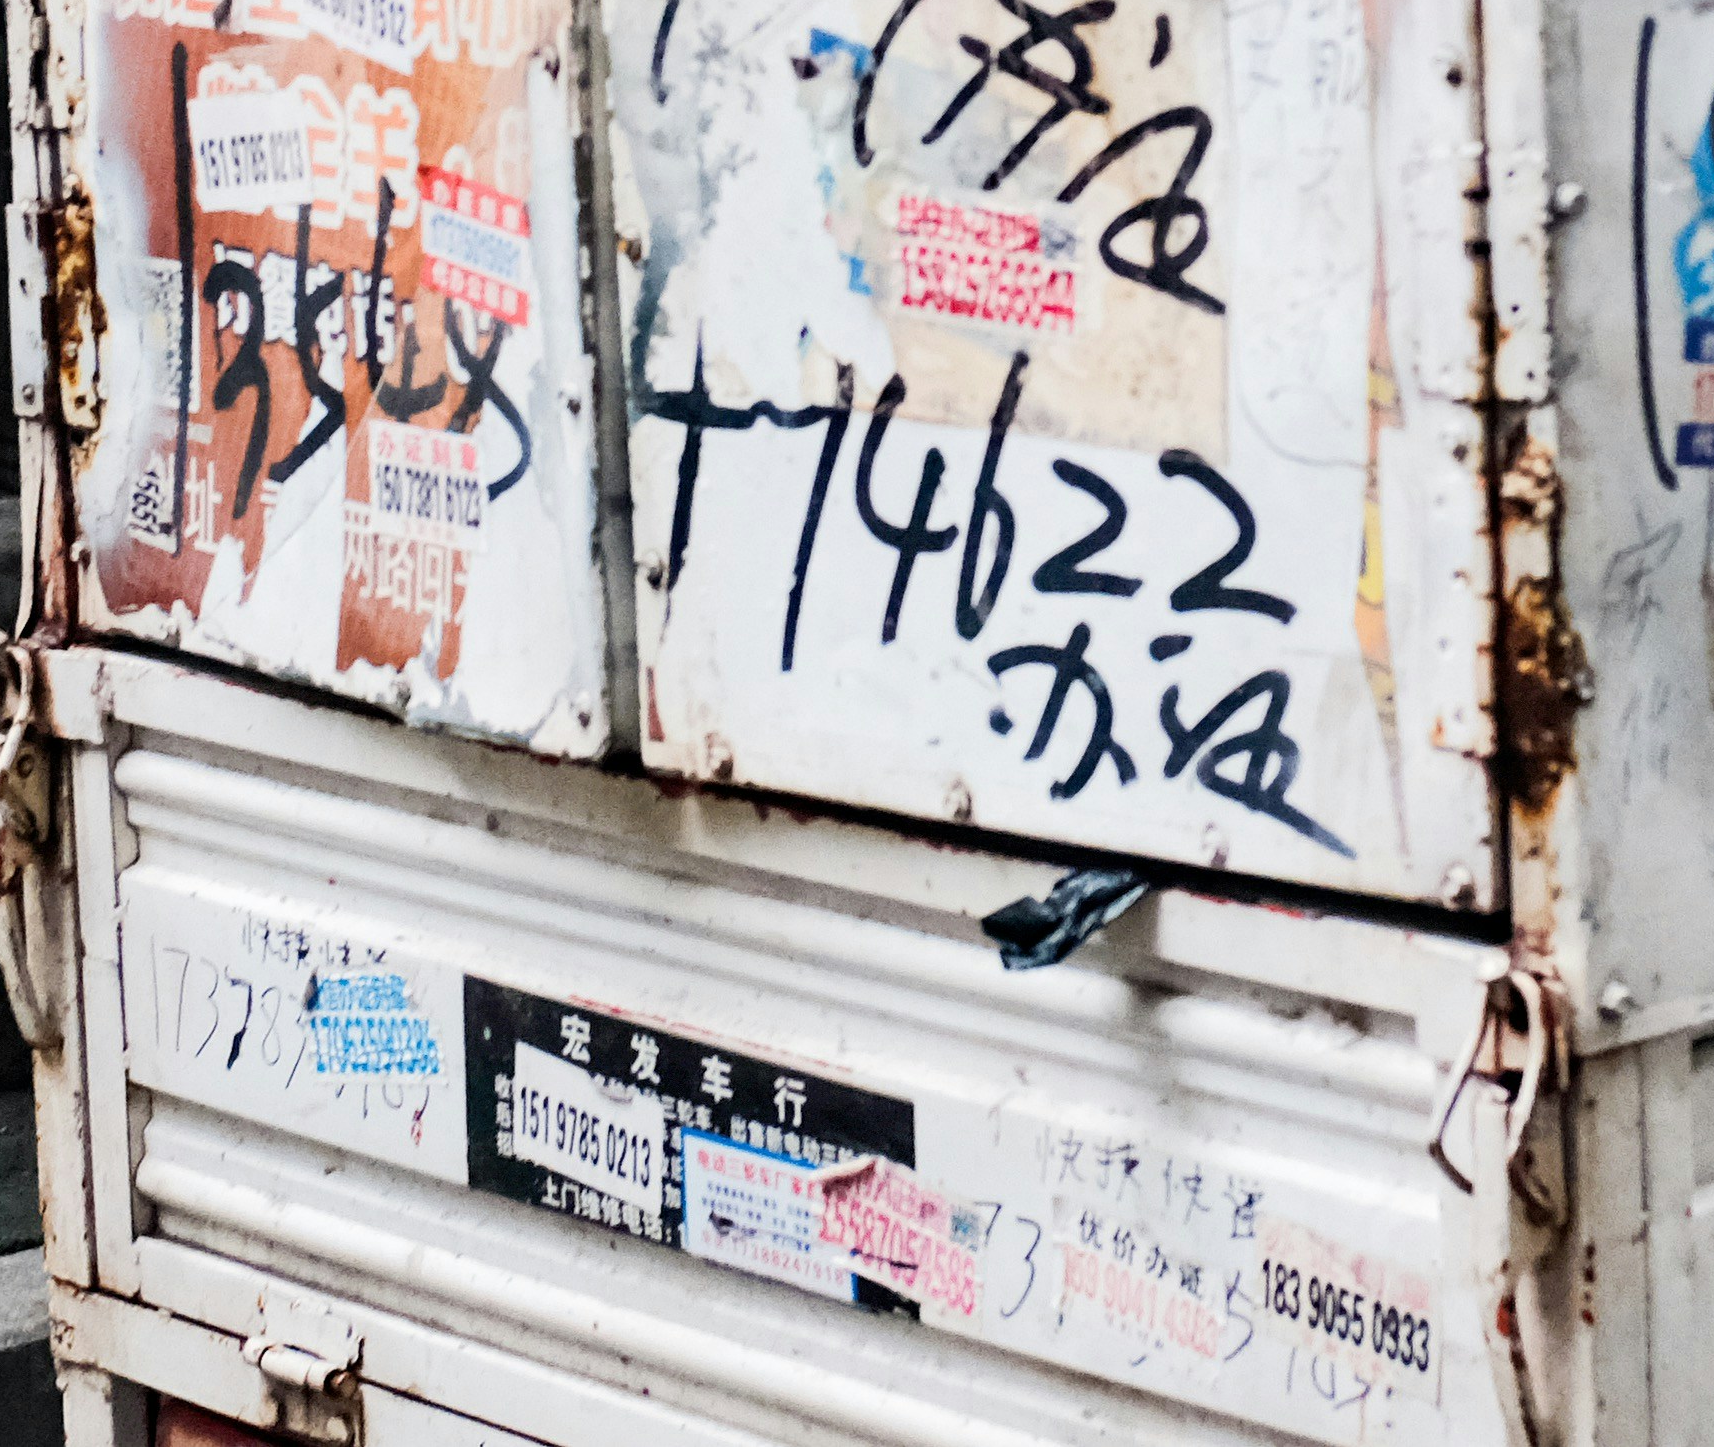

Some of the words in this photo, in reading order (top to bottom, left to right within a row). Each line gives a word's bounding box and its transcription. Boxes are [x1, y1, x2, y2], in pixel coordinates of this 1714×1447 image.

[560, 1012, 808, 1129] 宏发车行
[520, 1086, 550, 1145] 151
[556, 1101, 601, 1167] 9785
[606, 1122, 652, 1189] 0213
[1262, 1258, 1302, 1321] 183
[1308, 1274, 1366, 1347] 9055
[1371, 1299, 1432, 1374] 0933
